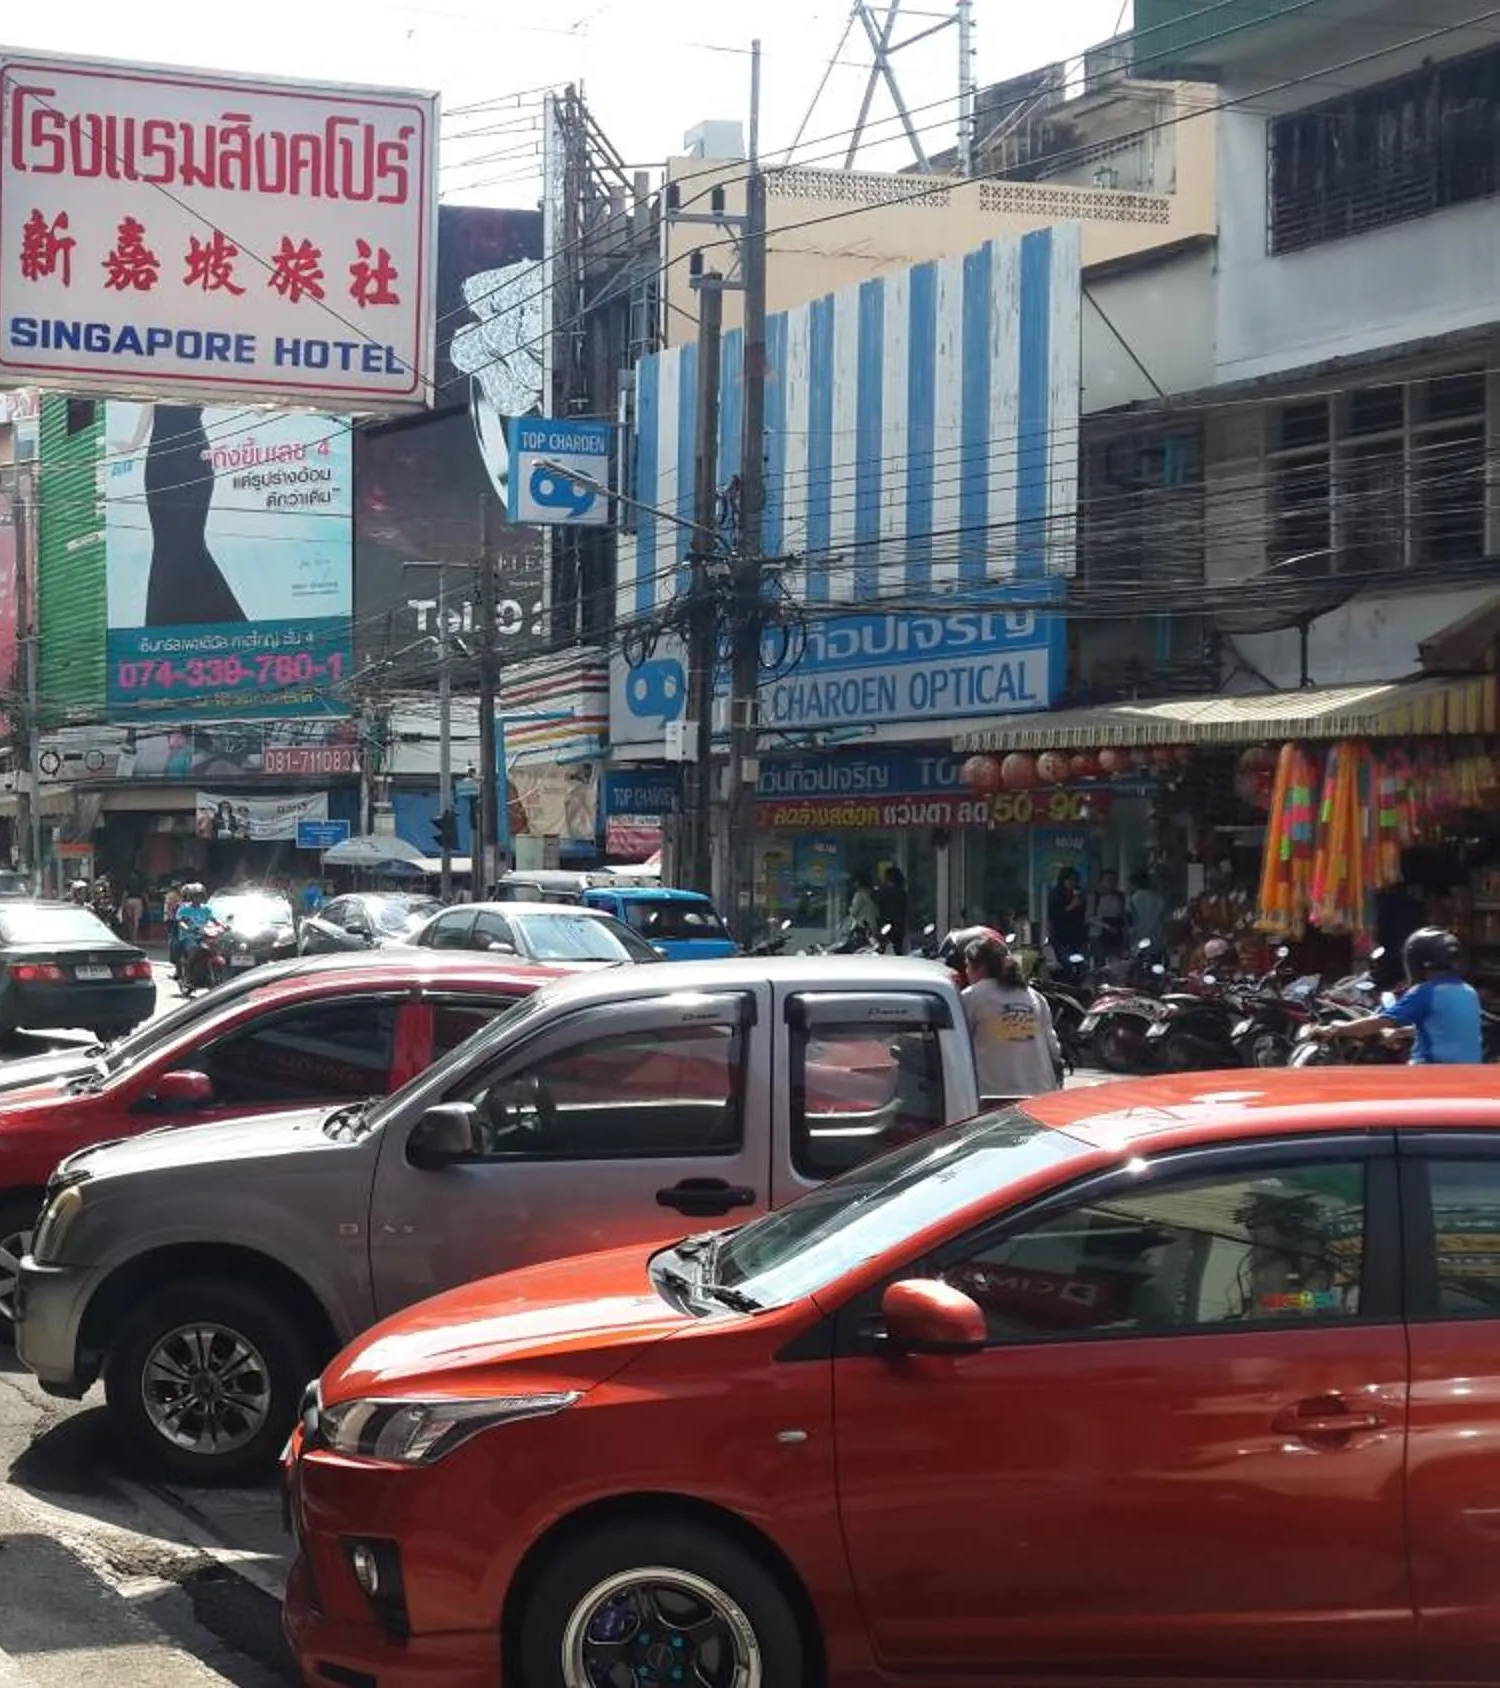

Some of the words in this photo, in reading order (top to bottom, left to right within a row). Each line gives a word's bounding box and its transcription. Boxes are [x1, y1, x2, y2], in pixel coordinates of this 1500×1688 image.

[11, 86, 416, 206] โรงแรมสิงคโปร์
[20, 208, 401, 308] 新嘉坡旅社
[10, 317, 256, 364] SINGAPORE
[275, 336, 405, 376] HOTEL
[522, 431, 545, 450] TOP
[549, 433, 605, 452] CHAROEN
[770, 674, 896, 721] CHAROEN
[908, 660, 1037, 710] OPTICAL
[265, 750, 358, 773] 081-711082
